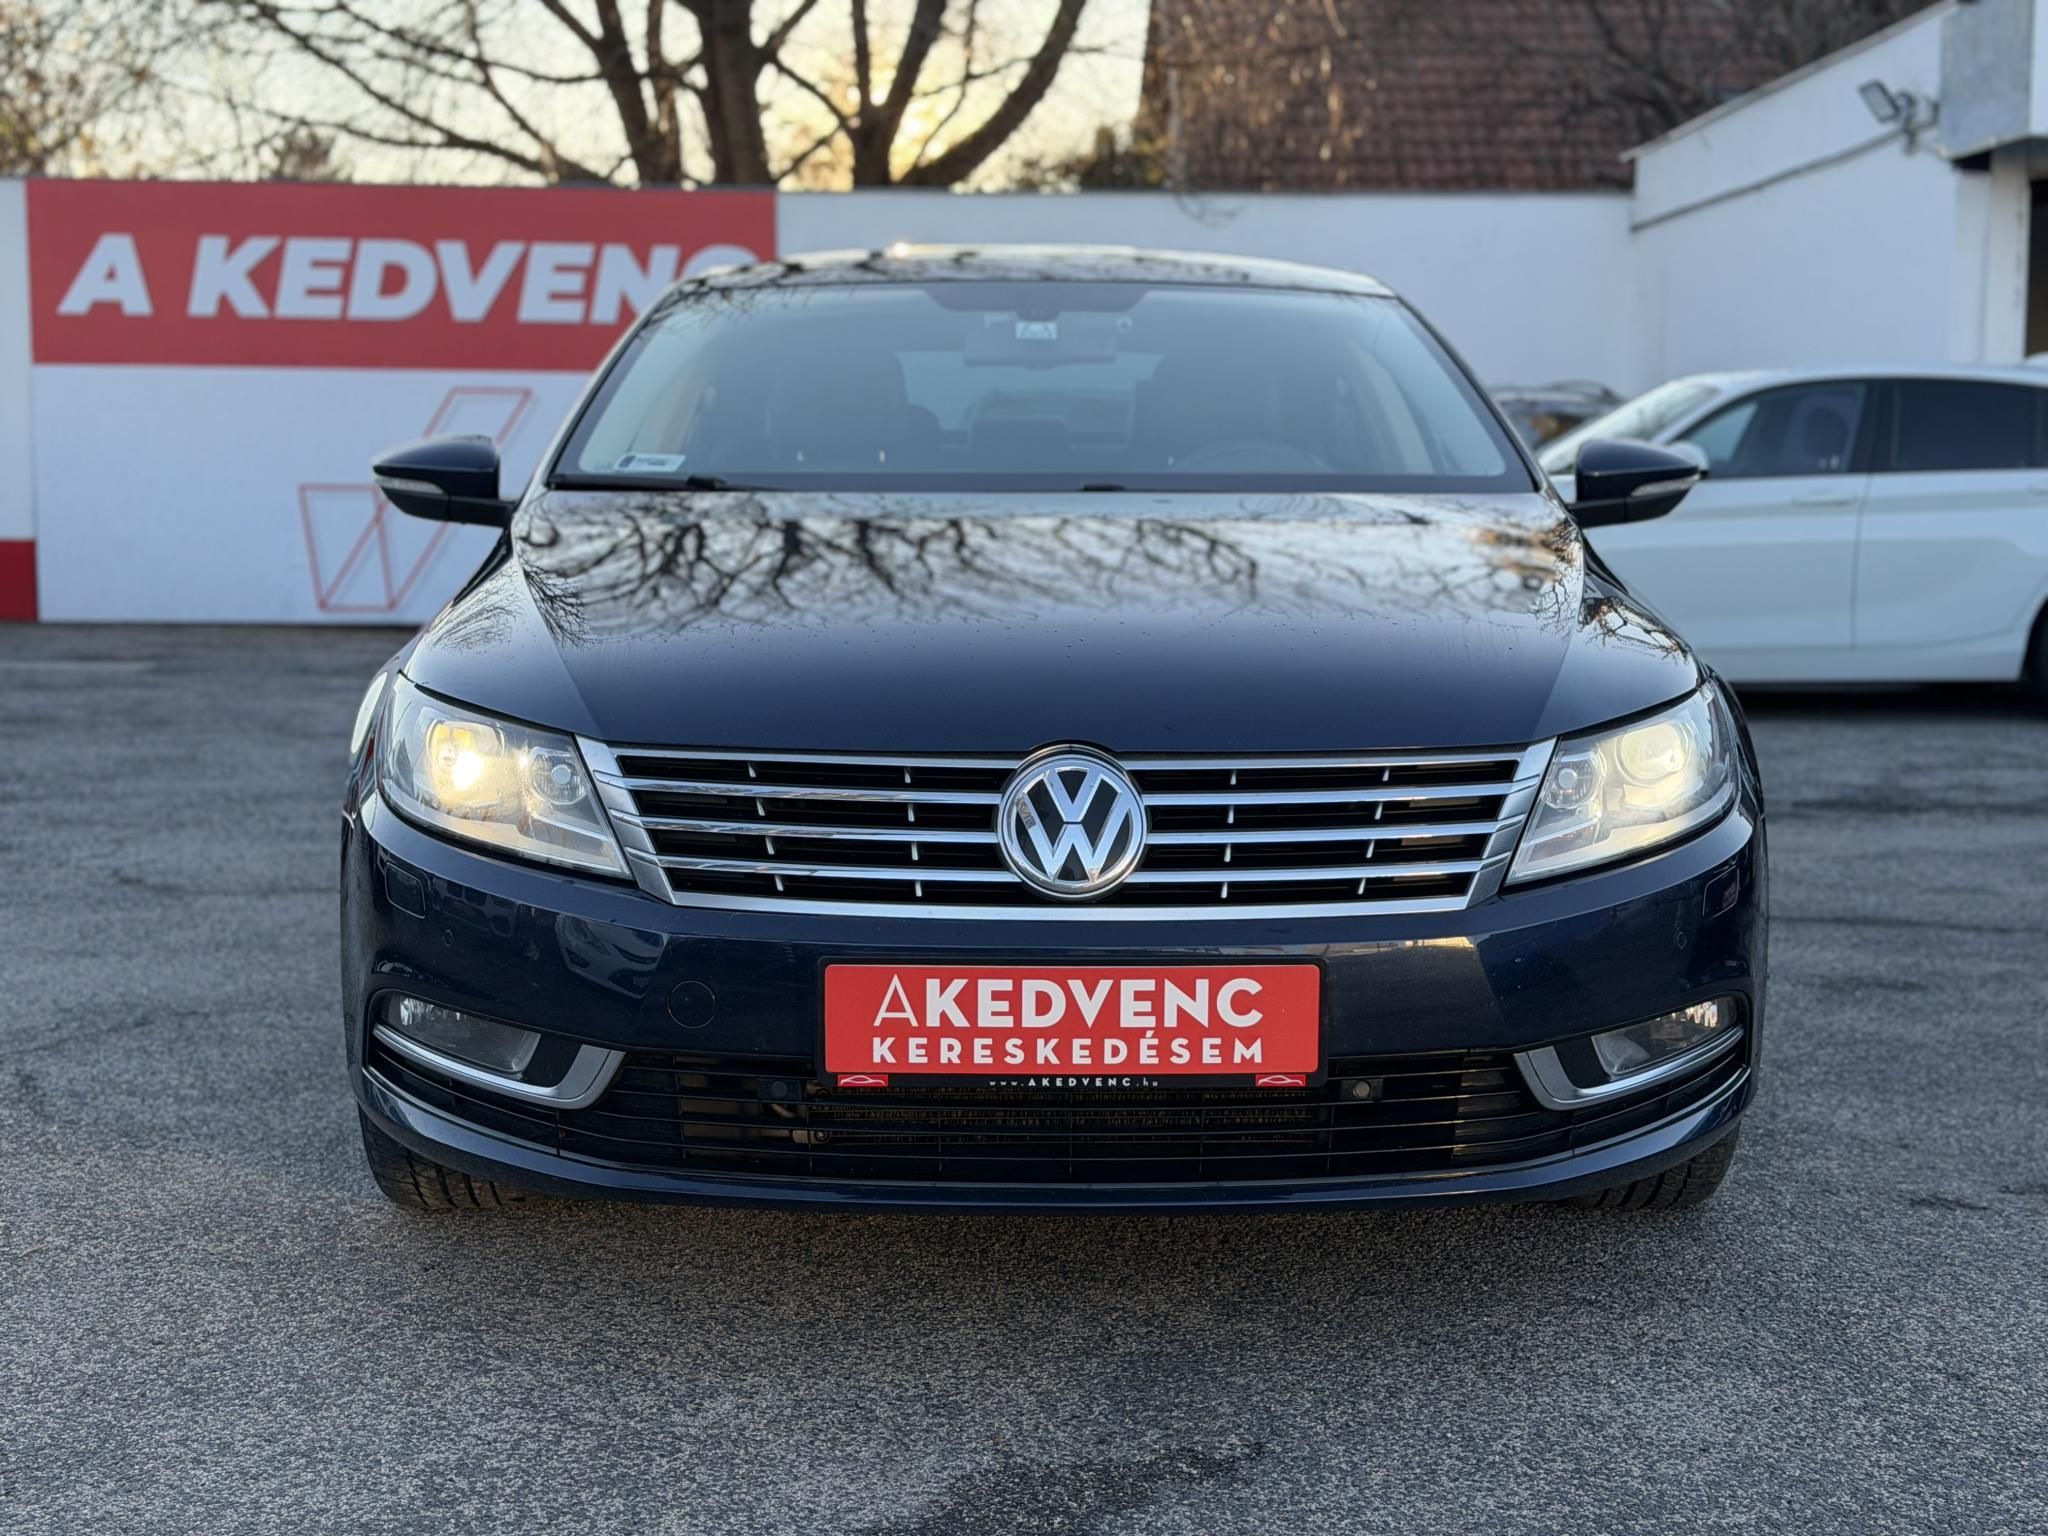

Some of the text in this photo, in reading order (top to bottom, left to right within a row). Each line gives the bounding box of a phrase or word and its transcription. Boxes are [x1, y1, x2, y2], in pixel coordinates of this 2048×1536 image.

[57, 233, 760, 325] A KEDVEN
[872, 1030, 1263, 1065] KERESKEDÉSEM
